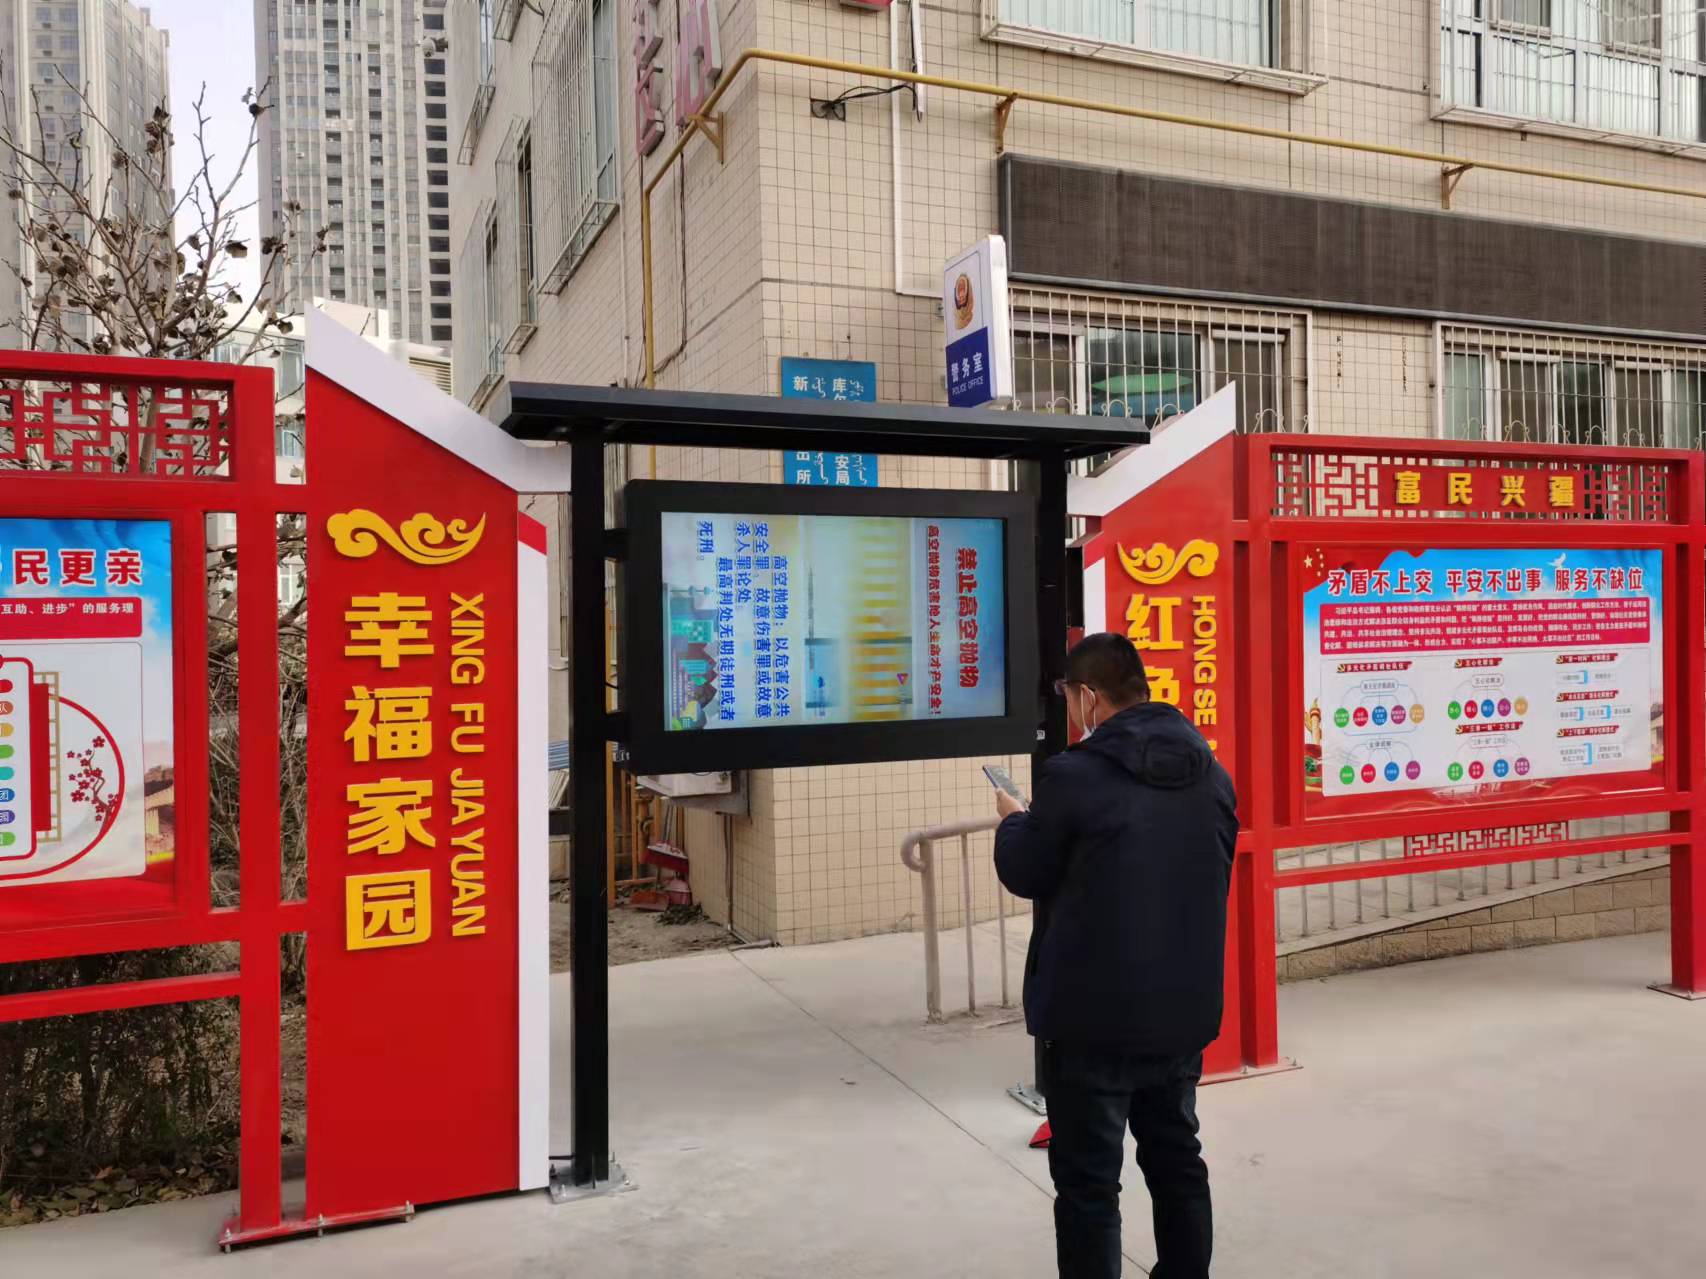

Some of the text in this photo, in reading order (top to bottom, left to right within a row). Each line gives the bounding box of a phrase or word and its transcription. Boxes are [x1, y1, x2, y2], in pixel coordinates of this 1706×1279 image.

[951, 352, 983, 383] 警务室
[952, 375, 983, 396] POLICE OFFICE
[13, 548, 142, 586] 民更亲
[1327, 567, 1643, 595] 矛盾不上交 平安不出事 服务不缺位
[449, 592, 485, 684] XING
[717, 557, 735, 721] 最高判处无期徒刑或者
[957, 547, 980, 688] 禁止高空抛物
[1192, 595, 1217, 684] HONG
[449, 703, 485, 753] FU
[1193, 688, 1217, 726] SE
[344, 591, 436, 951] 幸福家园
